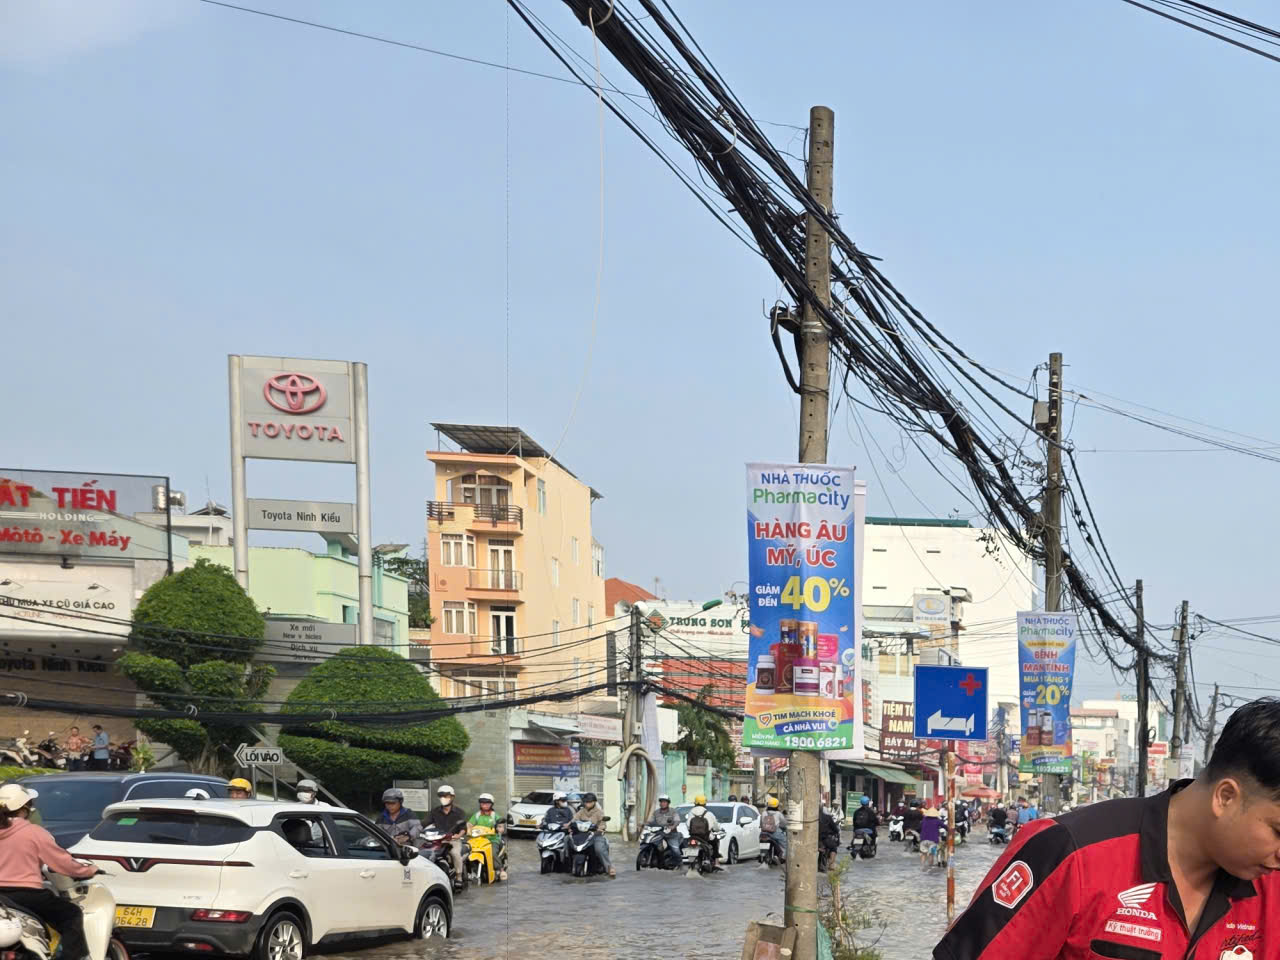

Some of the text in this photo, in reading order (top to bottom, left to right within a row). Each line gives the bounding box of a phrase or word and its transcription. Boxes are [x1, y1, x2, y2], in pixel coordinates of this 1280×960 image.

[247, 420, 345, 442] TOYOTA
[761, 470, 841, 486] NHÀ THUỐC
[52, 480, 117, 511] TIẾN
[753, 486, 850, 510] Pharmacity
[40, 512, 94, 521] HOLDING
[262, 510, 340, 523] Toyota Ninh Kiều
[755, 518, 848, 542] HÀNG ÂU
[60, 529, 85, 545] Xe
[89, 530, 131, 551] Máy
[767, 544, 837, 568] MỸ, ÚC
[755, 575, 850, 612] GIẢM 40%
[72, 599, 91, 609] GIÁ
[93, 601, 115, 610] CAO
[758, 595, 777, 607] ĐẾN
[669, 616, 707, 627] TRUNG
[1020, 626, 1073, 638] Pharmacity
[788, 711, 811, 721] MẠCH
[883, 701, 903, 718] TIỆM
[794, 722, 811, 731] NHÀ
[812, 722, 826, 731] VUI
[889, 720, 913, 733] NAM
[784, 736, 847, 747] 1800 6821
[245, 749, 279, 762] LỐI VÀO
[123, 907, 143, 917] 64H
[1116, 907, 1158, 920] HONDA
